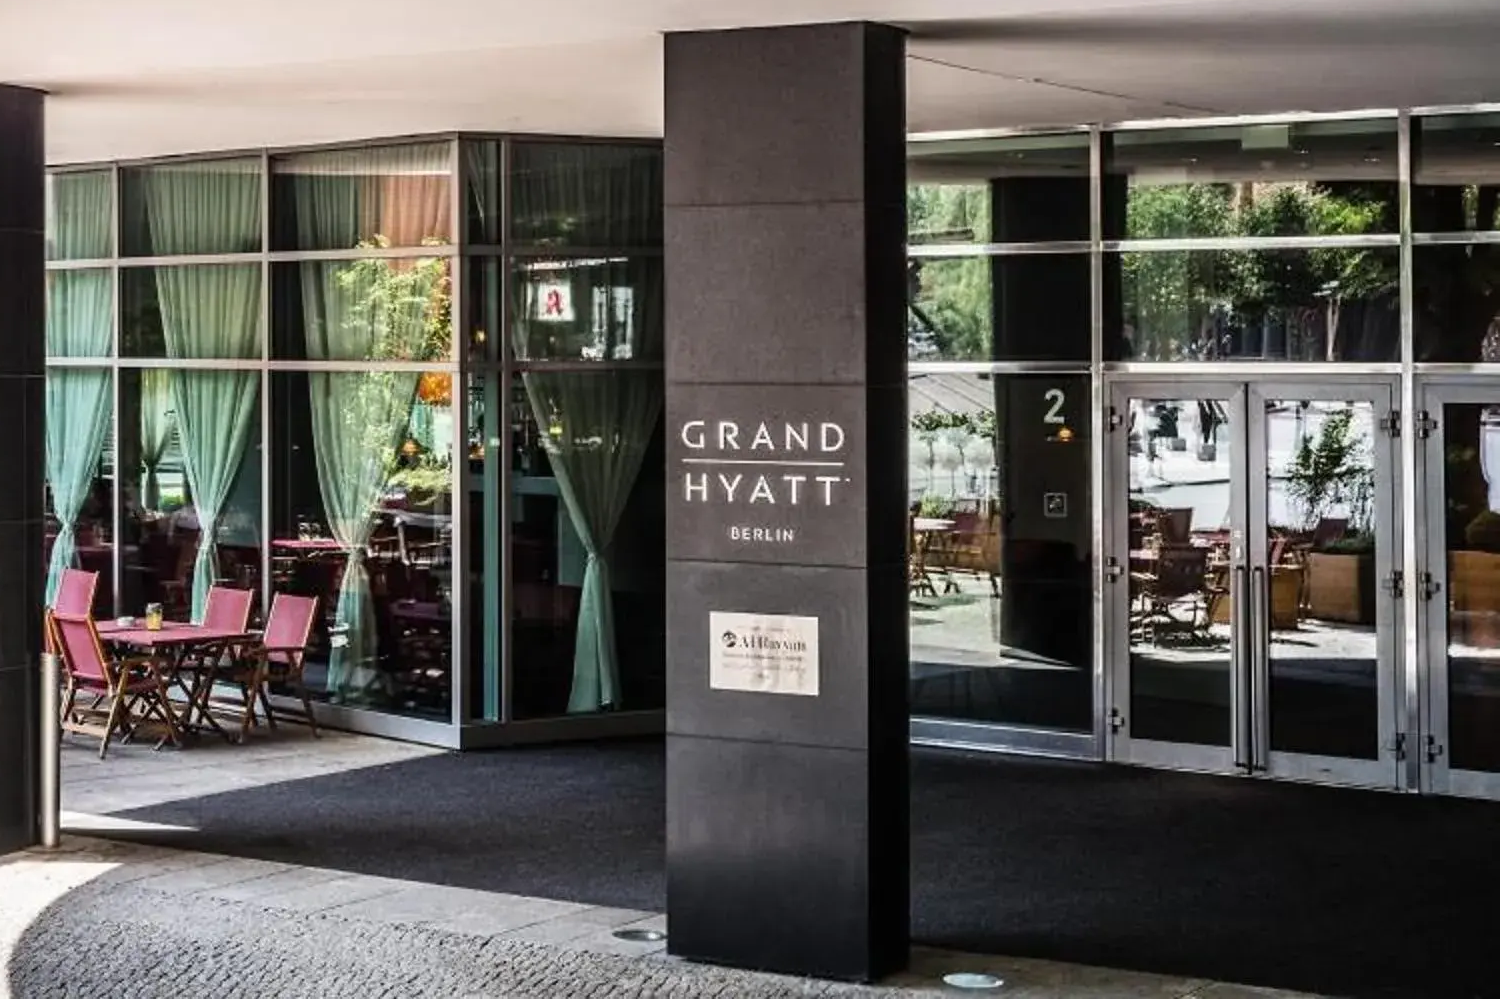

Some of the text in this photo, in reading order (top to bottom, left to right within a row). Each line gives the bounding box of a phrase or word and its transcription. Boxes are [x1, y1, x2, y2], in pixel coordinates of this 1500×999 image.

[1043, 388, 1065, 424] 2
[681, 420, 845, 452] GRAND
[685, 472, 842, 506] HYATT
[731, 526, 794, 542] BERLIN
